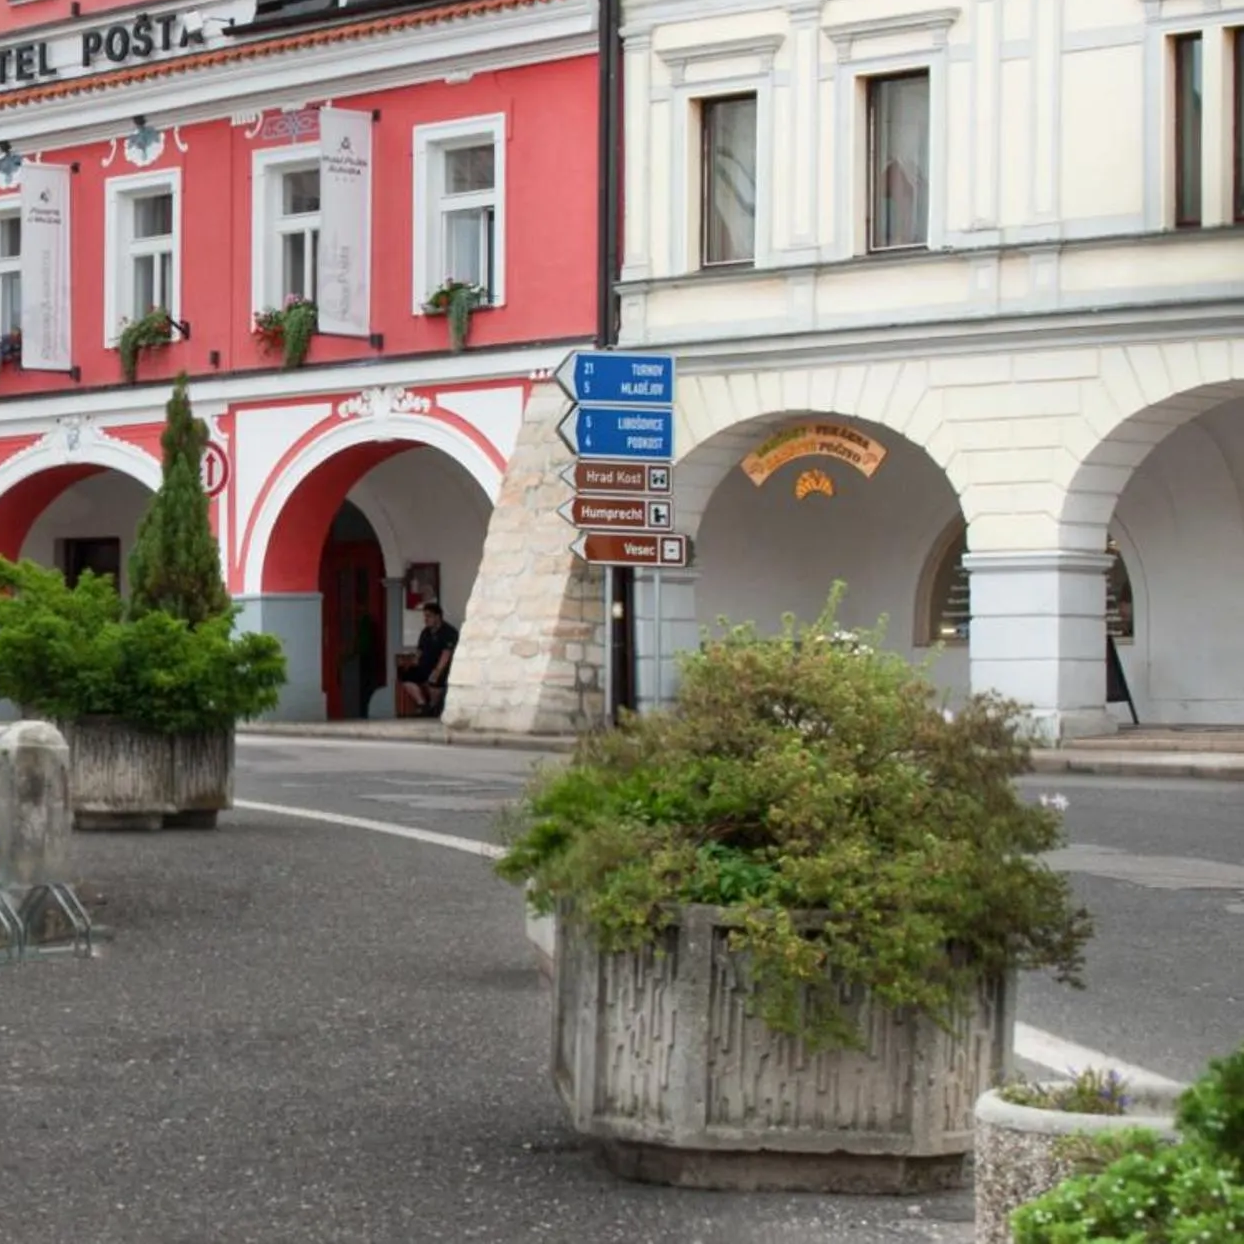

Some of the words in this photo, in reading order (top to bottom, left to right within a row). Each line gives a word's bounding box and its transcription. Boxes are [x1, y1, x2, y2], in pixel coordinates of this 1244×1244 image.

[82, 13, 204, 67] POŠTA
[584, 362, 594, 375] 21
[632, 363, 664, 377] TURNOV
[584, 381, 590, 394] 5
[627, 436, 663, 449] PODKOST
[586, 470, 613, 484] Hrad
[617, 471, 641, 484] Kost
[581, 506, 643, 521] Humprecht
[624, 542, 656, 556] Vesec
